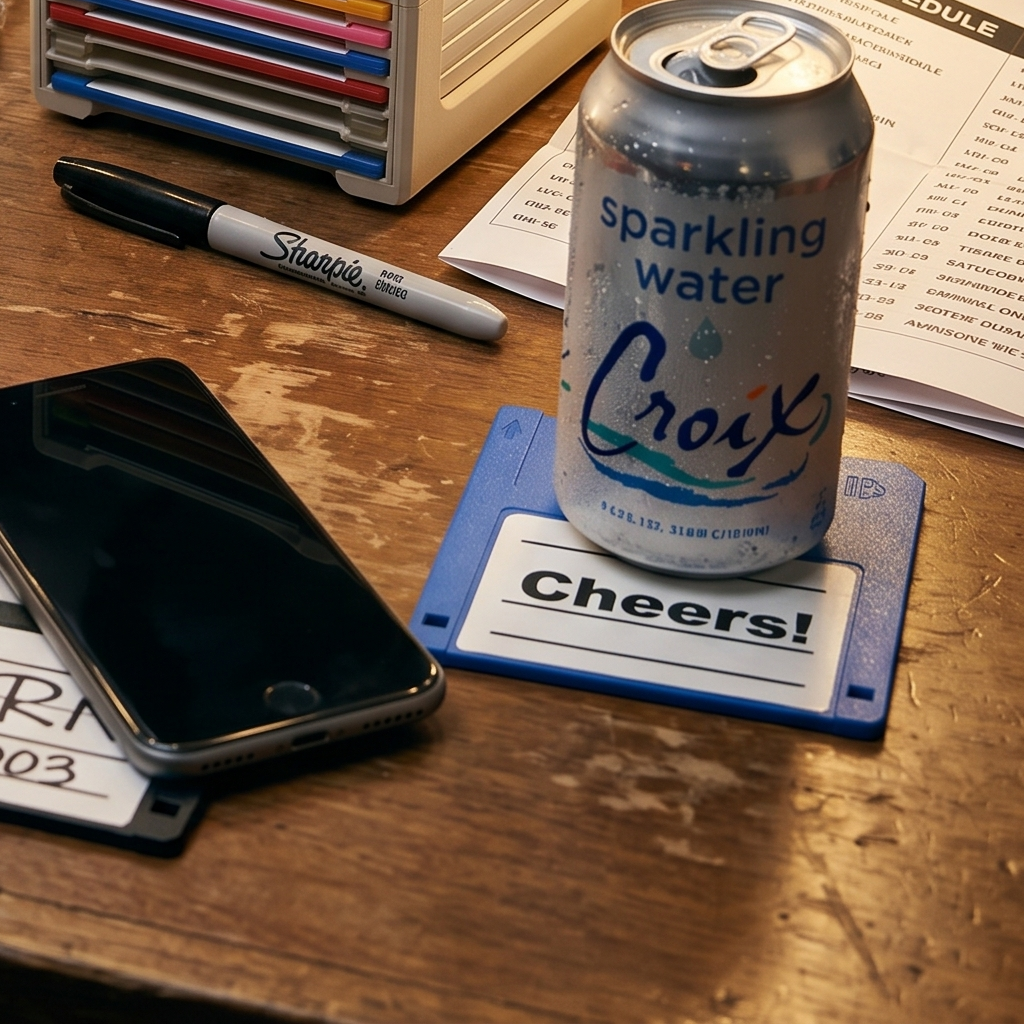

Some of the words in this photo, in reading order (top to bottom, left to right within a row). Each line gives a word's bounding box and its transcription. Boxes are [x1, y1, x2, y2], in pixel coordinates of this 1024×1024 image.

[600, 196, 826, 258] sparkling
[635, 258, 785, 305] water
[581, 321, 824, 477] Croix
[520, 570, 814, 644] Cheers!
